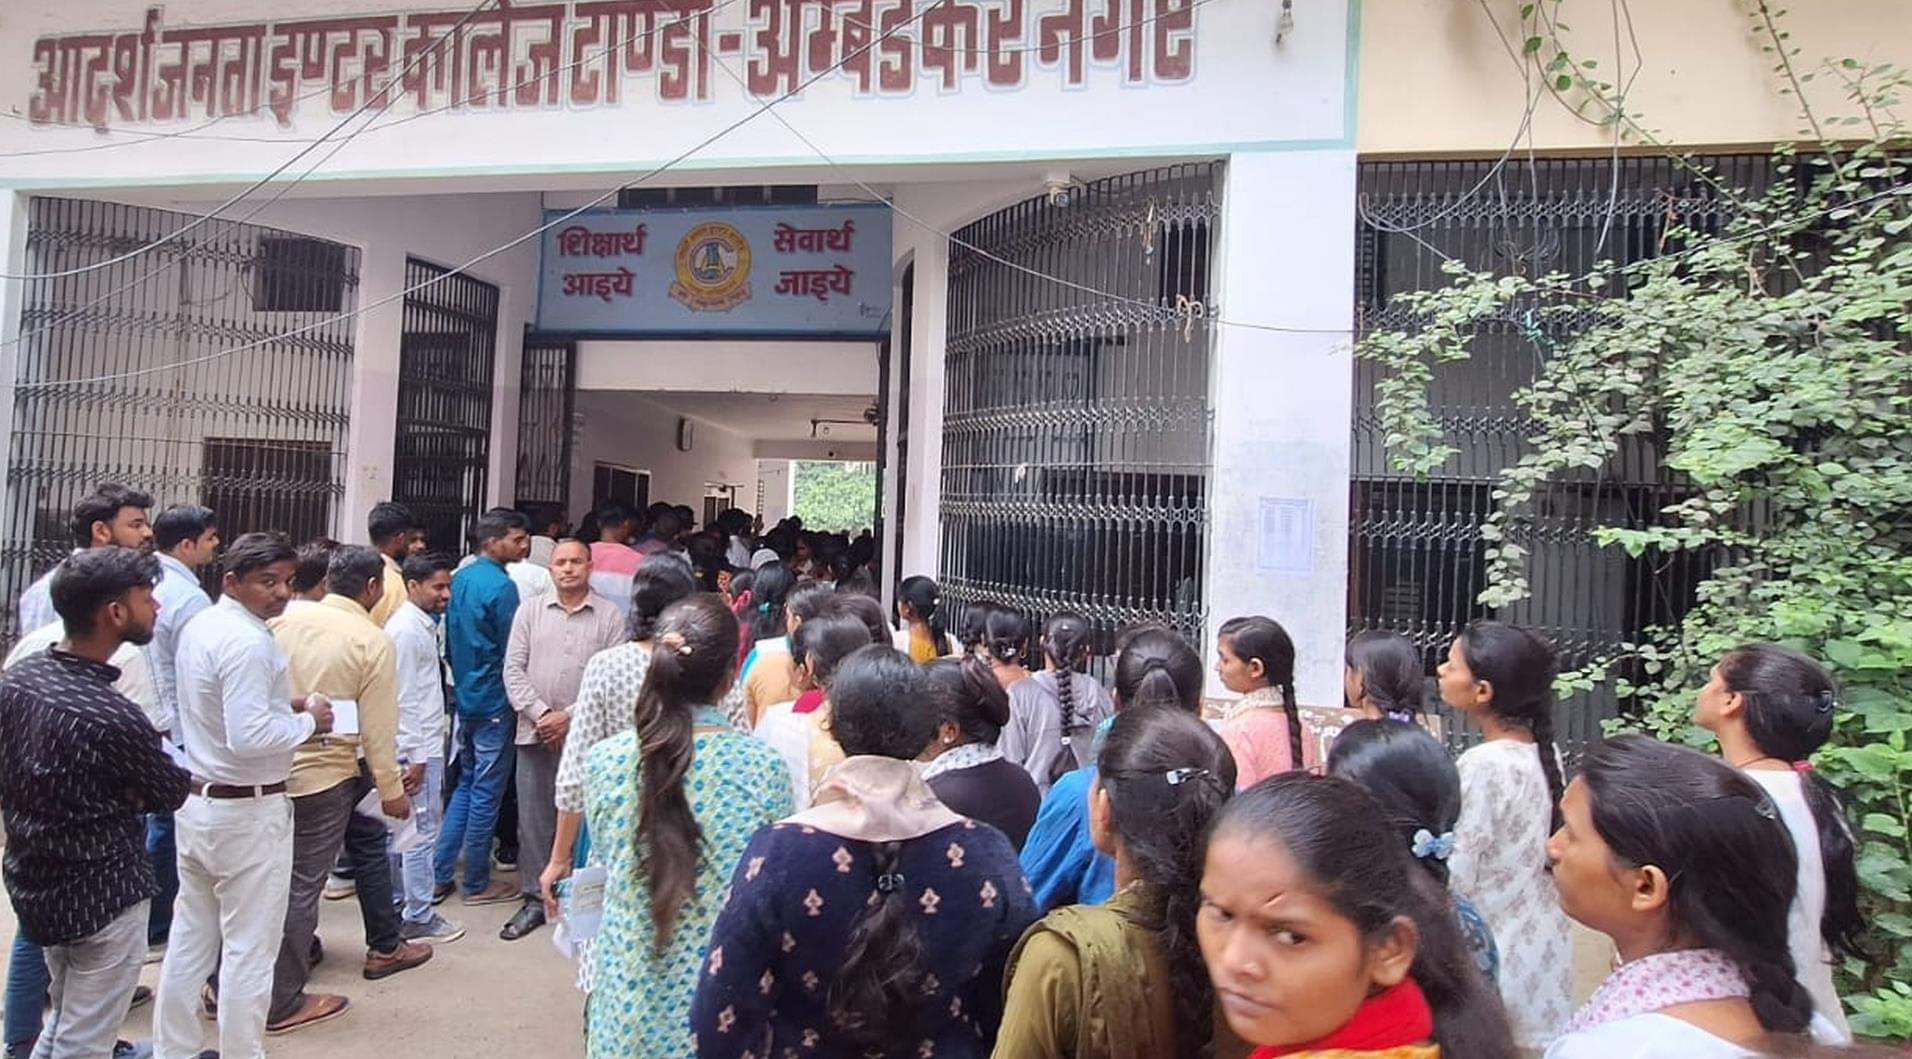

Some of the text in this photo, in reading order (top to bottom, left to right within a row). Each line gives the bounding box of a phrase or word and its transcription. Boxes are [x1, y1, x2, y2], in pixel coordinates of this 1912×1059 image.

[29, 8, 160, 134] आदर्श
[153, 27, 266, 119] जनता
[269, 15, 398, 129] इण्टर
[557, 223, 647, 257] शिक्षार्थ
[773, 218, 855, 253] सेवार्थ
[562, 267, 636, 301] आइये
[773, 263, 855, 302] जाइये
